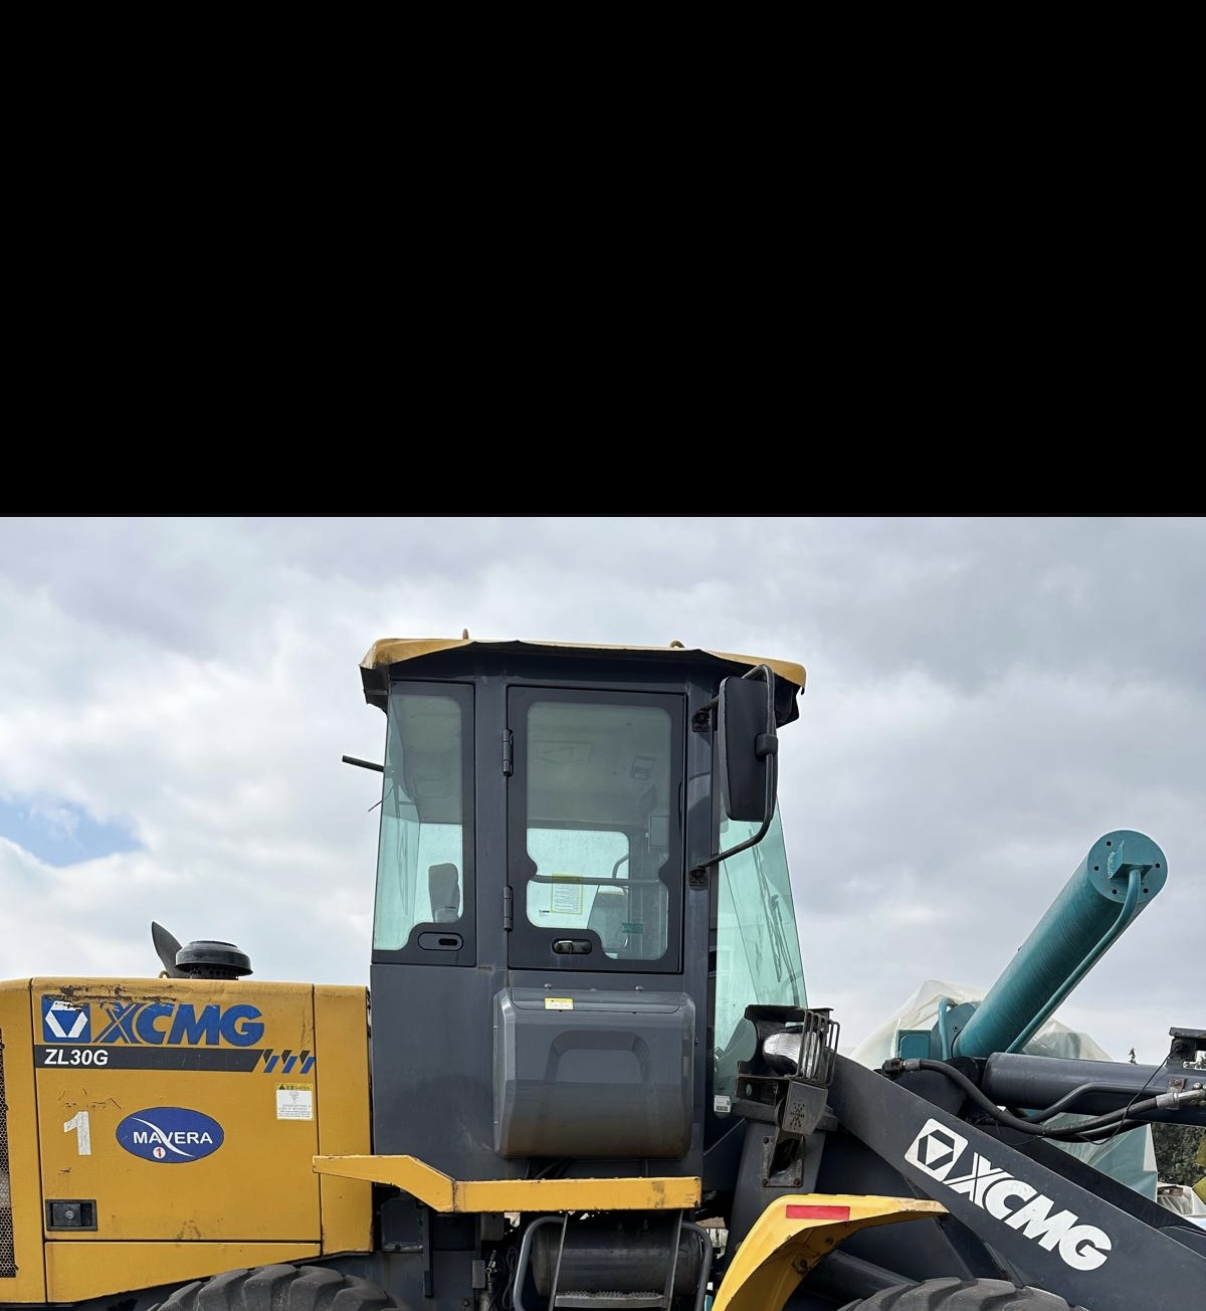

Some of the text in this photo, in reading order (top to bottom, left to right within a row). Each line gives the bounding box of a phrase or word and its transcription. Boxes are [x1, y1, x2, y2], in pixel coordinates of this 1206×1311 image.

[92, 1002, 265, 1047] XCMG
[44, 1049, 109, 1066] ZL30G
[63, 1111, 91, 1155] 1
[133, 1131, 213, 1144] MAVERA
[942, 1152, 1112, 1271] XCMG
